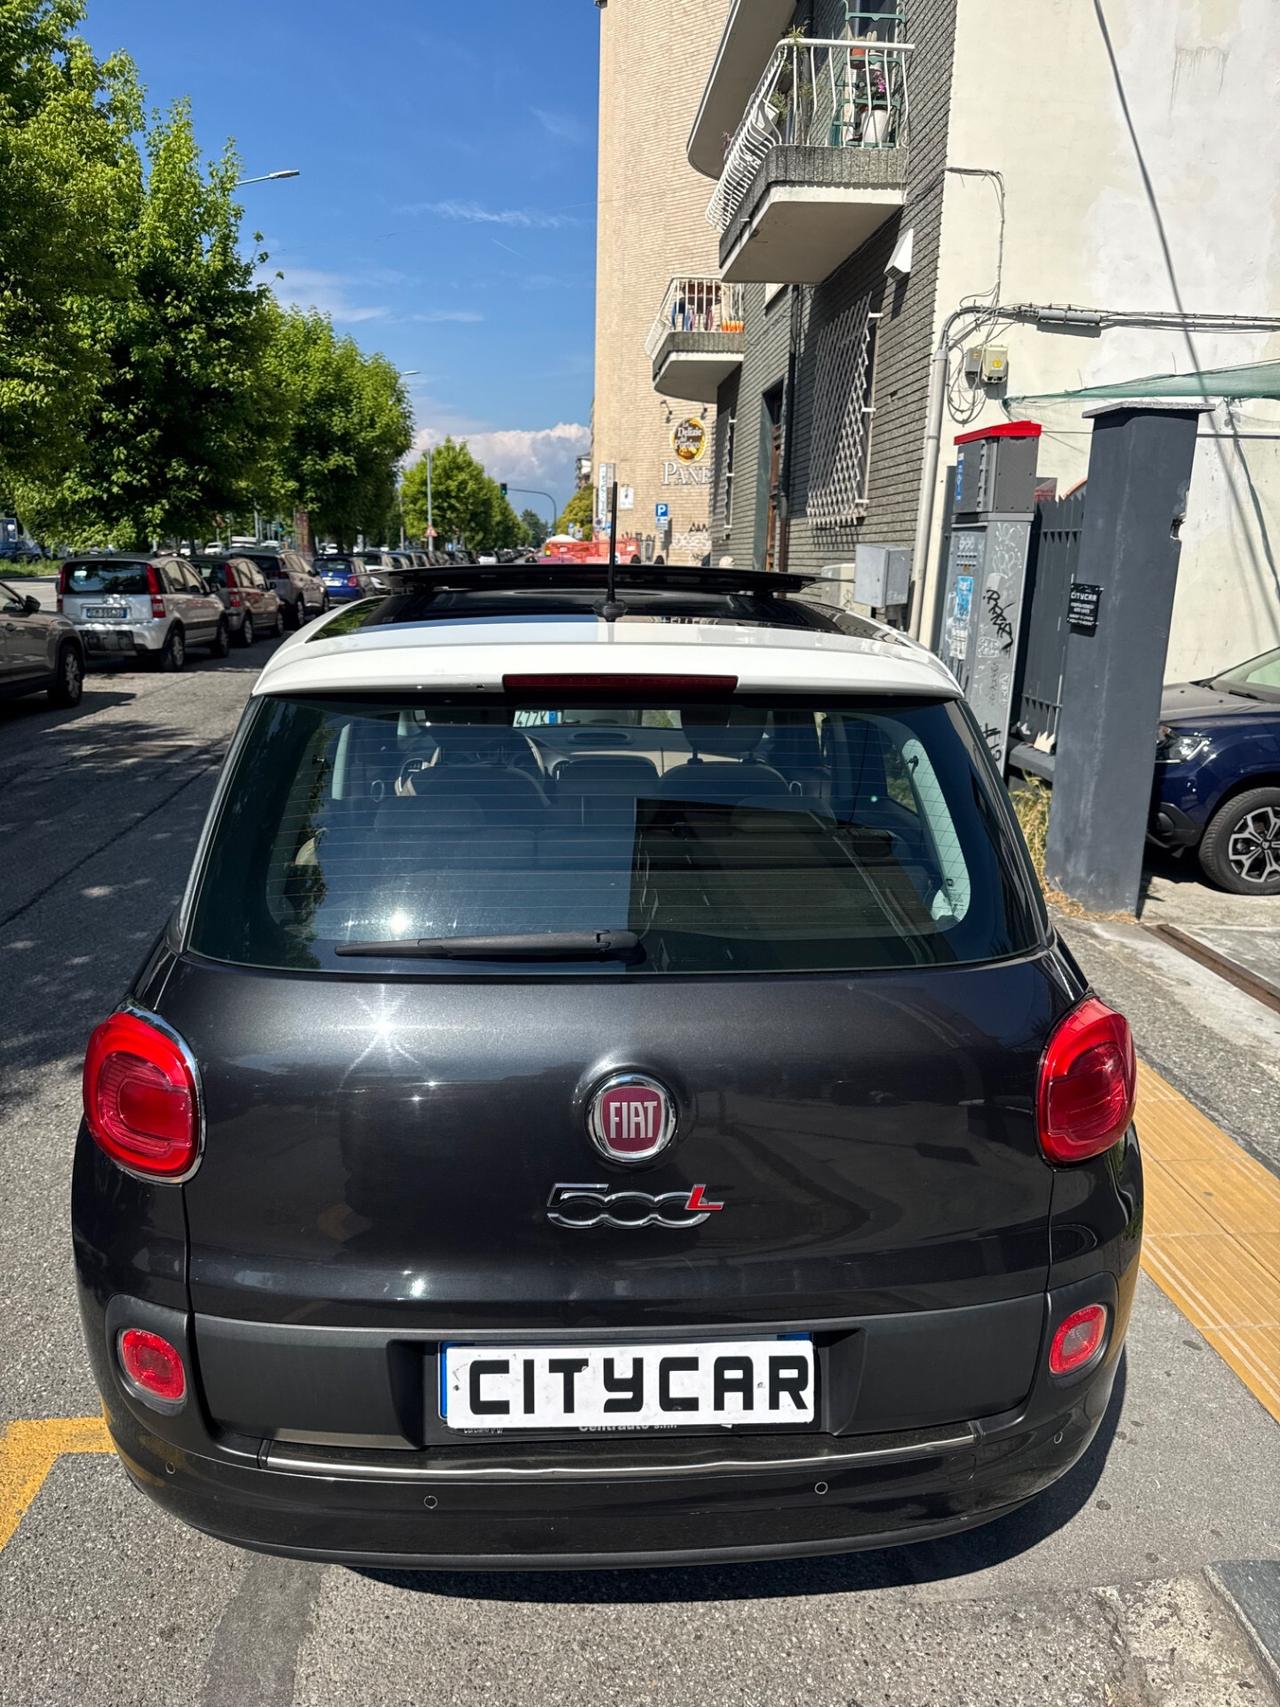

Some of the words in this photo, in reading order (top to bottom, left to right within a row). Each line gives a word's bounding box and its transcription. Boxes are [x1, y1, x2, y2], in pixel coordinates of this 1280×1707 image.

[657, 504, 667, 516] P
[609, 1101, 658, 1139] FIAT
[546, 1183, 725, 1230] 500L
[468, 1355, 809, 1416] CITYCAR
